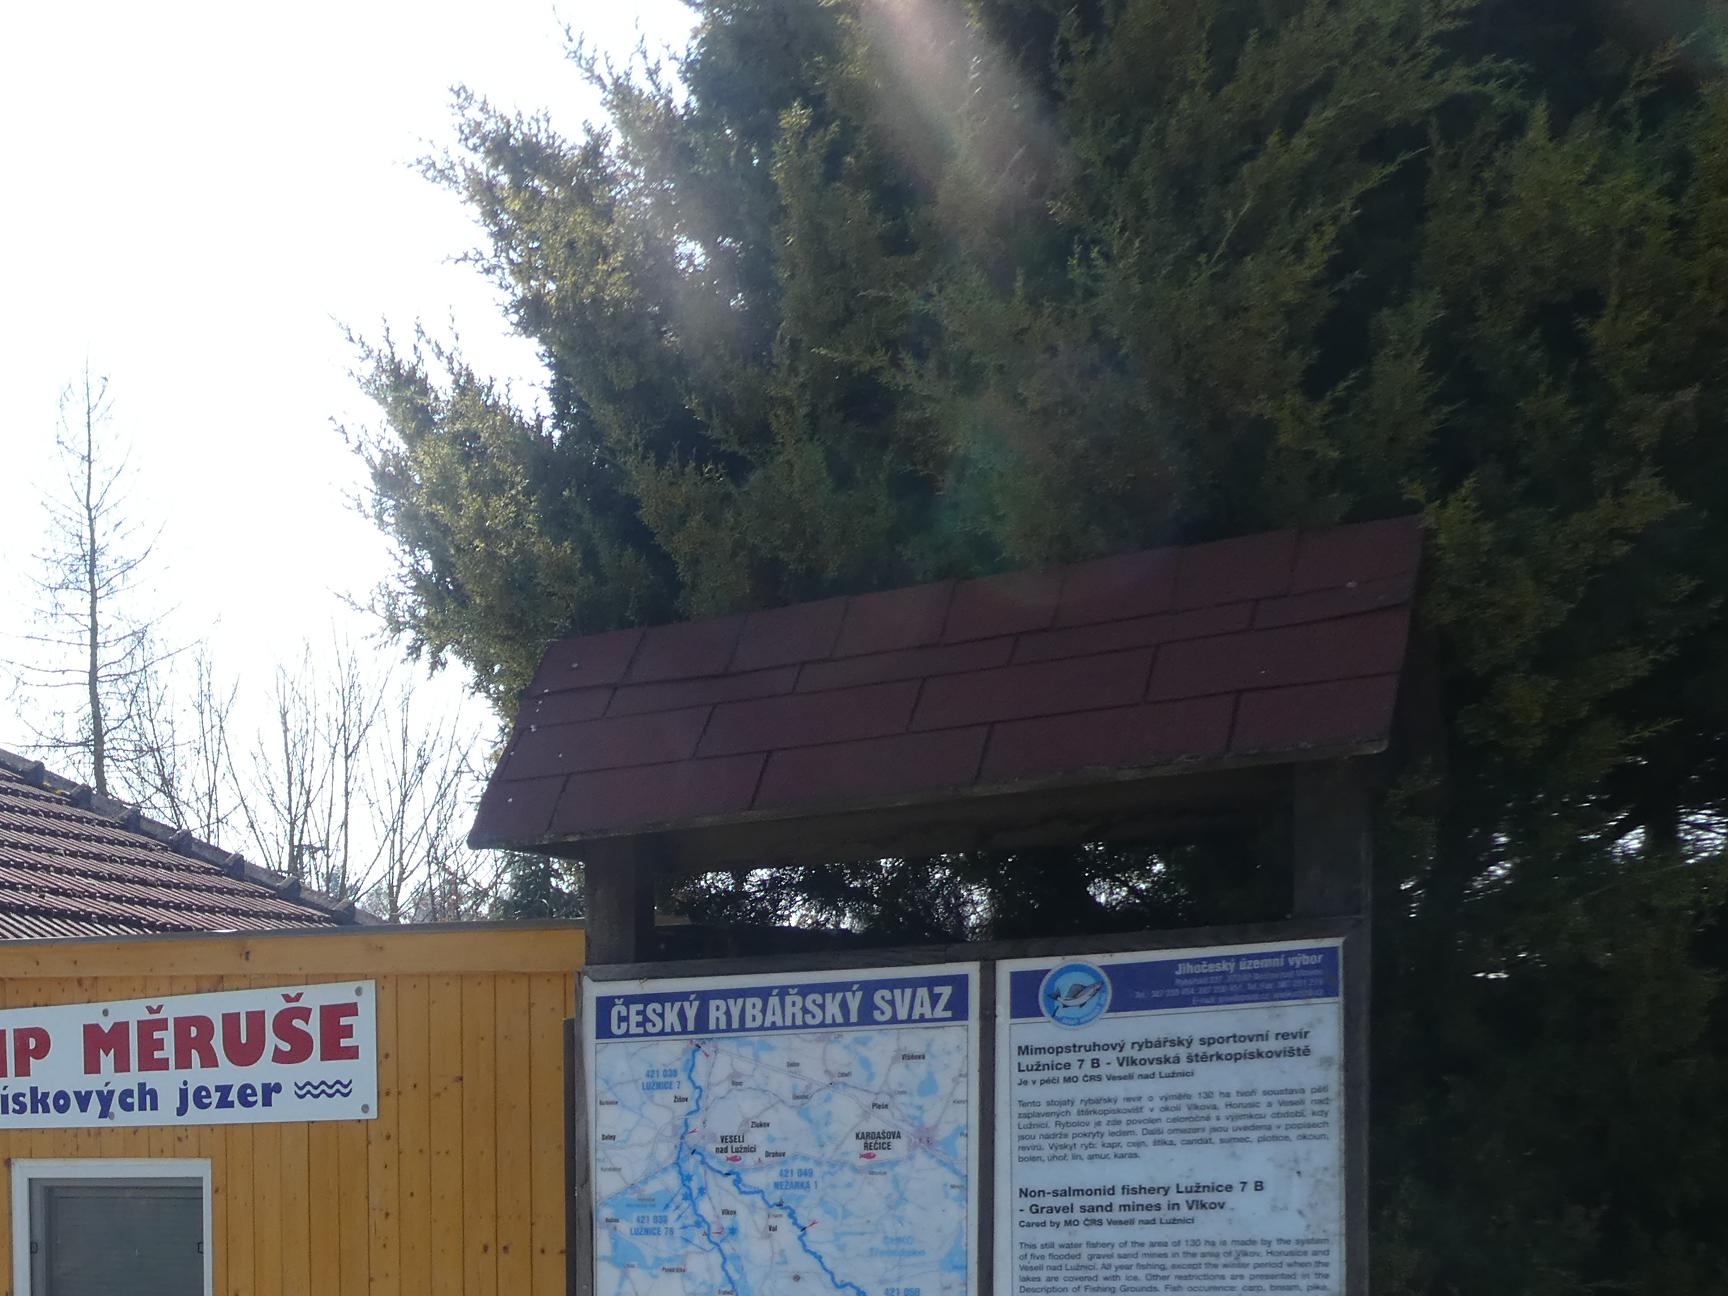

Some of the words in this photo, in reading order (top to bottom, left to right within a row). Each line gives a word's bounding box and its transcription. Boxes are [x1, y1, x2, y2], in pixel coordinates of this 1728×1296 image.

[1175, 959, 1235, 976] Jihočeský
[1239, 956, 1284, 969] územní
[1287, 953, 1323, 967] výbor
[611, 995, 698, 1035] ČESKÝ
[709, 982, 862, 1031] RYBÁŘSKÝ
[872, 984, 952, 1022] SVAZ
[83, 992, 360, 1075] MĚRUŠE
[1017, 1038, 1125, 1057] Mimopstruhový
[1131, 1035, 1192, 1051] rybářský
[1199, 1030, 1269, 1047] sportovní
[1275, 1028, 1309, 1041] revír
[1017, 1058, 1070, 1072] Lužnice
[1091, 1056, 1099, 1068] B
[1116, 1052, 1180, 1067] Vlkovská
[1186, 1045, 1310, 1066] štěrkopískoviště
[1017, 1077, 1028, 1086] Je
[1063, 1074, 1078, 1084] MO
[1082, 1072, 1102, 1082] ČRS
[1105, 1072, 1134, 1082] Veselí
[1137, 1071, 1155, 1080] nad
[175, 1079, 283, 1117] jezer
[720, 1133, 744, 1143] VESELÍ
[855, 1128, 901, 1140] KARDAŠOVA
[715, 1145, 727, 1153] nad
[1018, 1184, 1115, 1198] Non-salmonid
[1121, 1183, 1169, 1197] fishery
[1176, 1181, 1233, 1194] Lužnice
[1254, 1181, 1263, 1192] B
[721, 1208, 736, 1216] Vlkov
[1029, 1202, 1073, 1214] Gravel
[1079, 1201, 1112, 1213] sand
[1119, 1200, 1161, 1212] mines
[1167, 1200, 1180, 1211] in
[1185, 1199, 1225, 1211] Vlkov
[1019, 1219, 1046, 1227] Cared
[1049, 1218, 1060, 1228] by
[1064, 1218, 1079, 1227] MO
[1083, 1216, 1103, 1226] ČRS
[1138, 1216, 1155, 1225] nad
